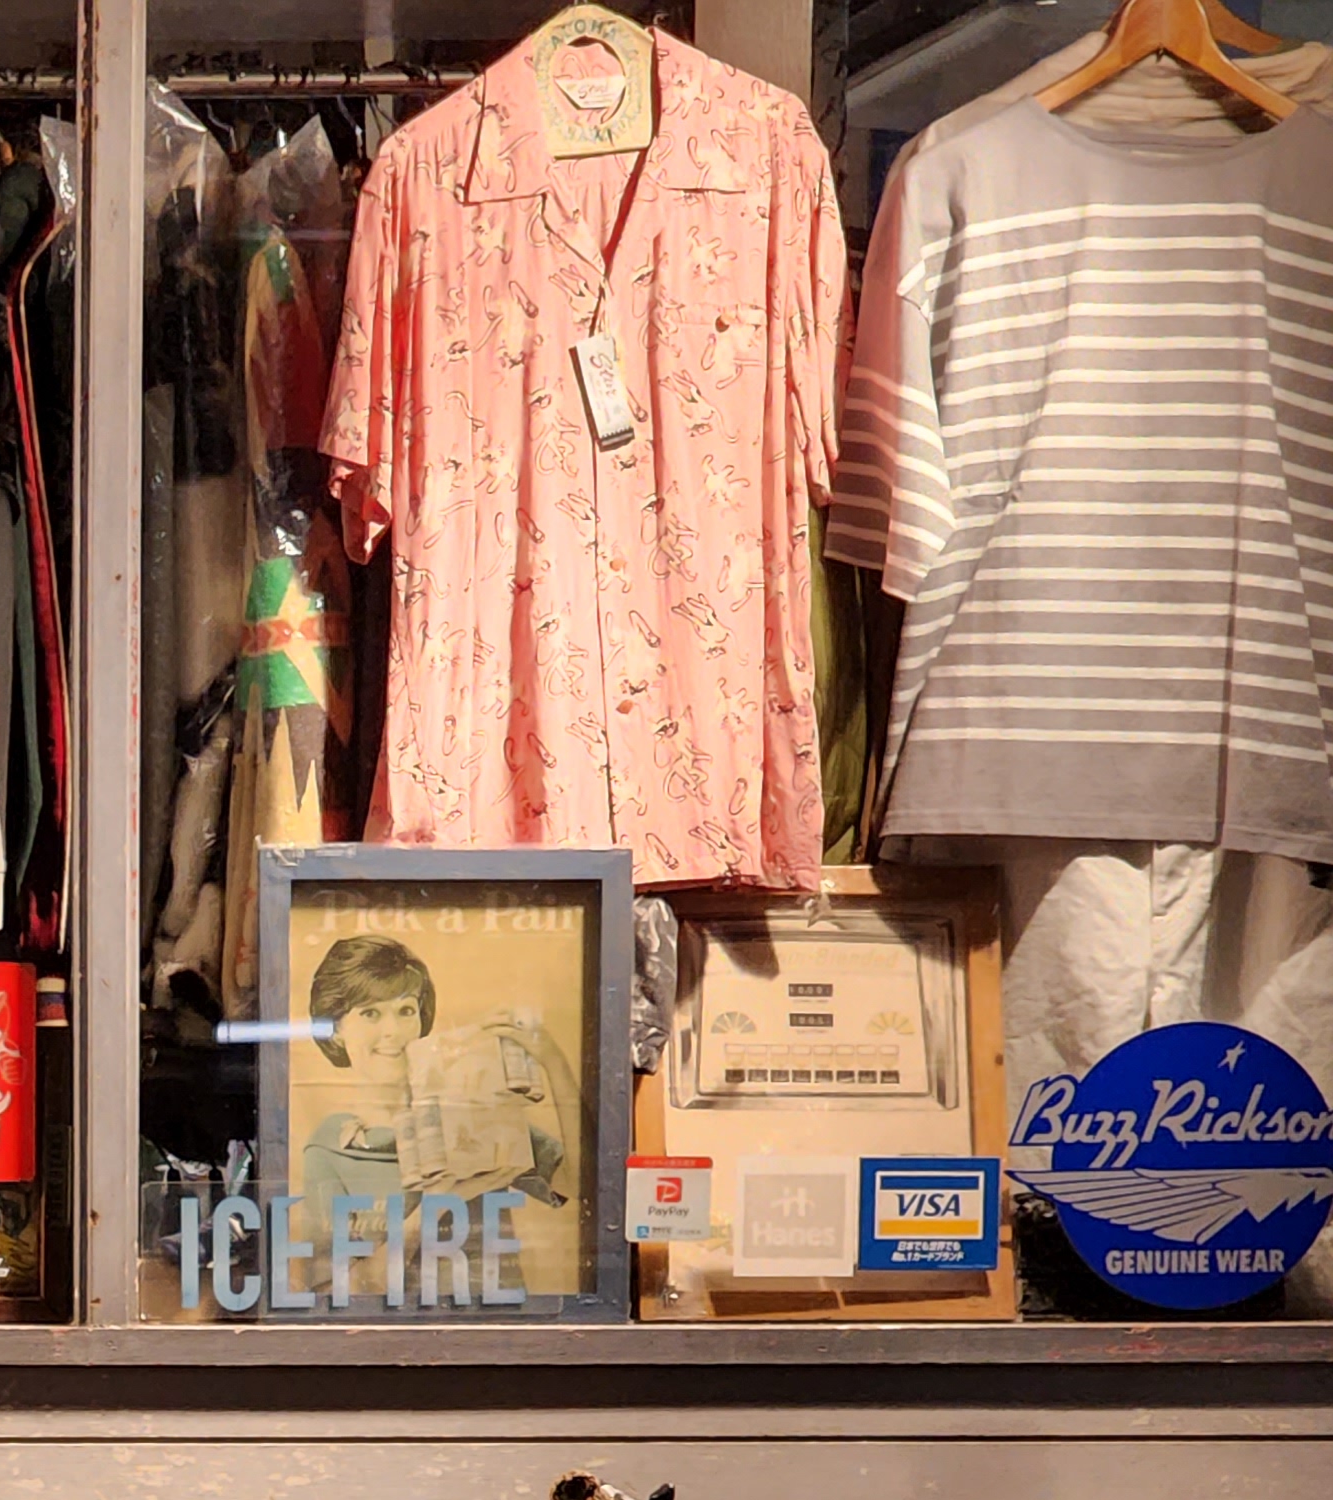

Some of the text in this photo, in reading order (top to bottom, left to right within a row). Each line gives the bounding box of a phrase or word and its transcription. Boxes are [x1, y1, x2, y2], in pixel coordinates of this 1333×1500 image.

[1010, 1077, 1139, 1170] Buzz
[648, 1206, 689, 1217] PayPay
[895, 1193, 961, 1217] VISA
[751, 1220, 837, 1248] Hanes
[1105, 1250, 1285, 1275] GENUINE WEAR
